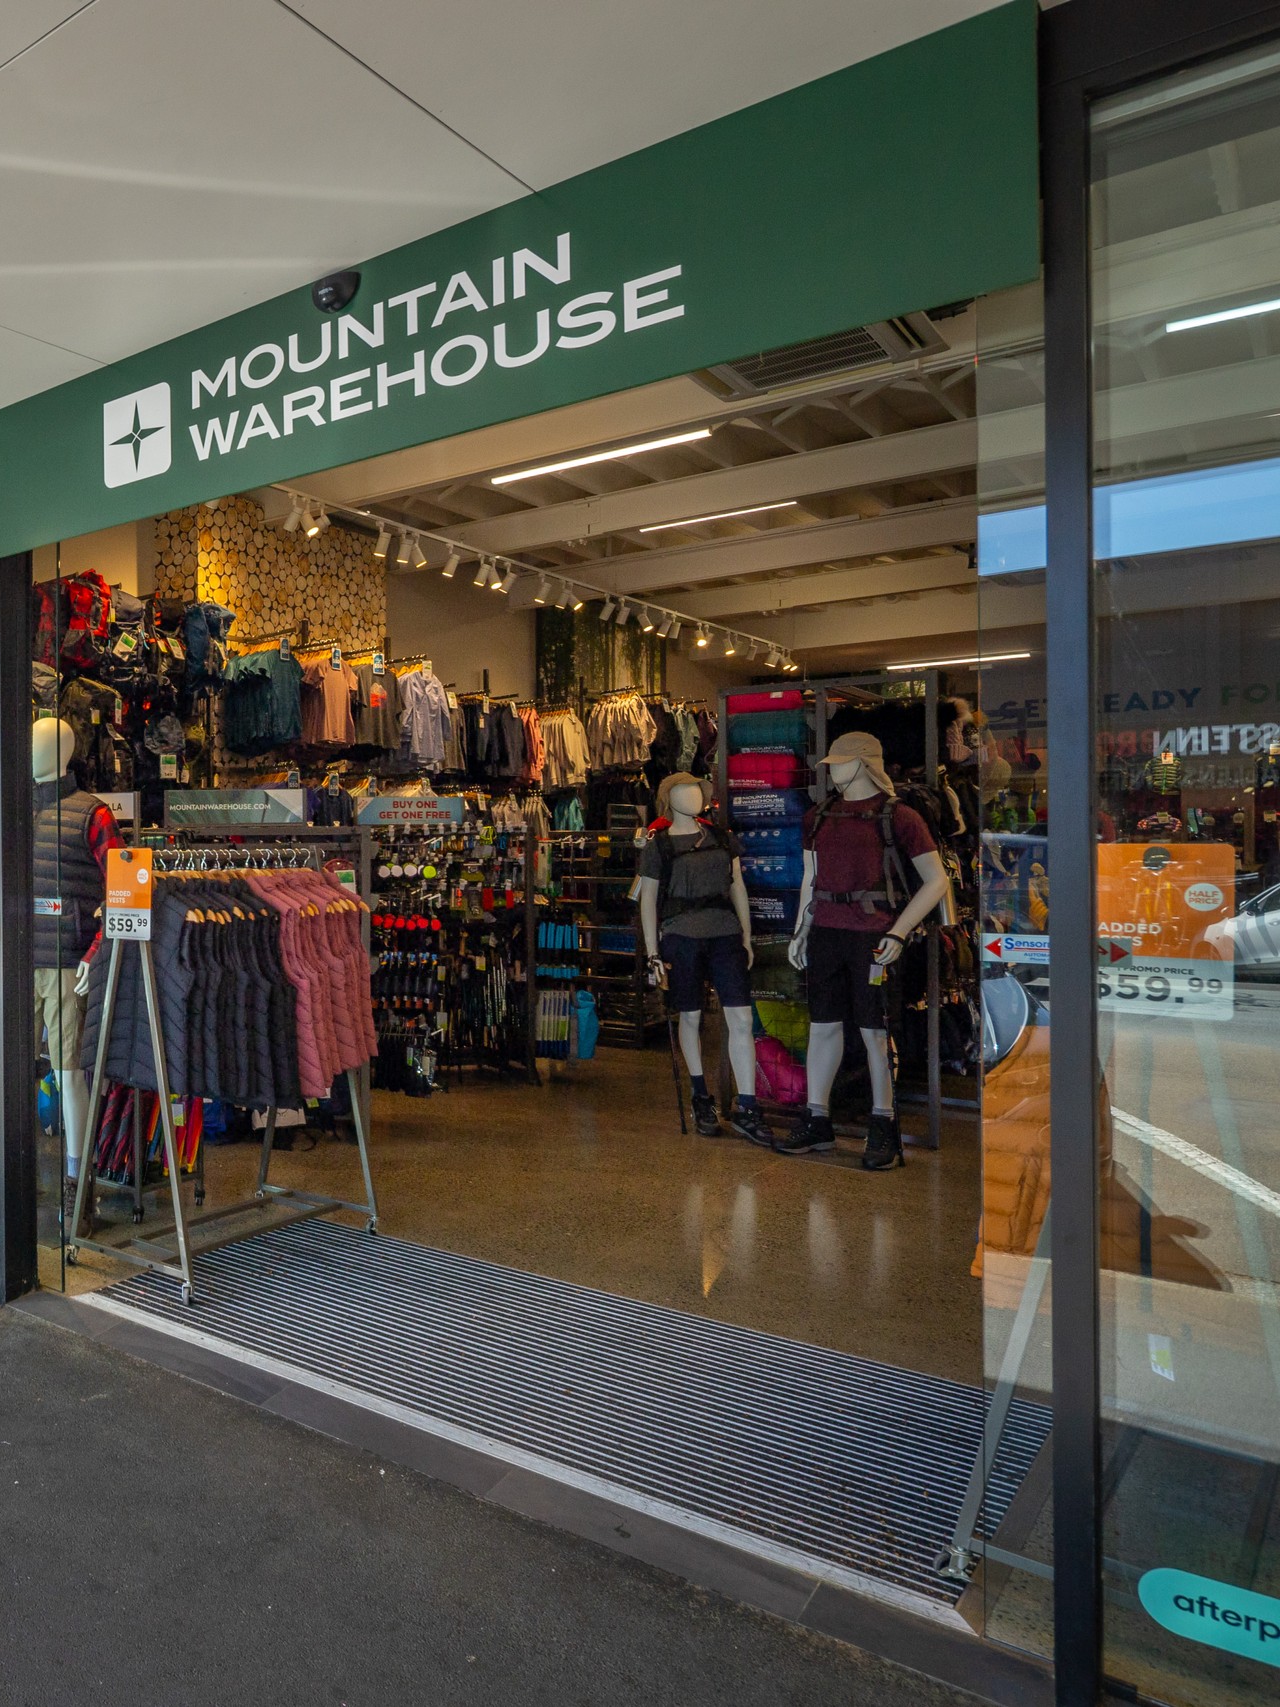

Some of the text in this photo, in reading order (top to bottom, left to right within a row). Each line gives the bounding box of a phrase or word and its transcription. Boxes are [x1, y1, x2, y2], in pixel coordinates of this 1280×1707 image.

[190, 231, 571, 410] MOUNTAIN
[188, 264, 686, 462] WAREHOUSE
[1099, 687, 1202, 714] EADY
[1222, 682, 1280, 706] FO
[169, 803, 272, 812] MOUNTAINWAREHOUSE.COM
[392, 800, 438, 809] BUY ONE
[378, 811, 451, 819] GET ONE FREE
[1188, 890, 1219, 898] HALF
[1188, 897, 1220, 905] PRICE
[1098, 922, 1162, 935] ADDED
[1164, 967, 1195, 976] PRICE
[1172, 1593, 1280, 1642] afterp
